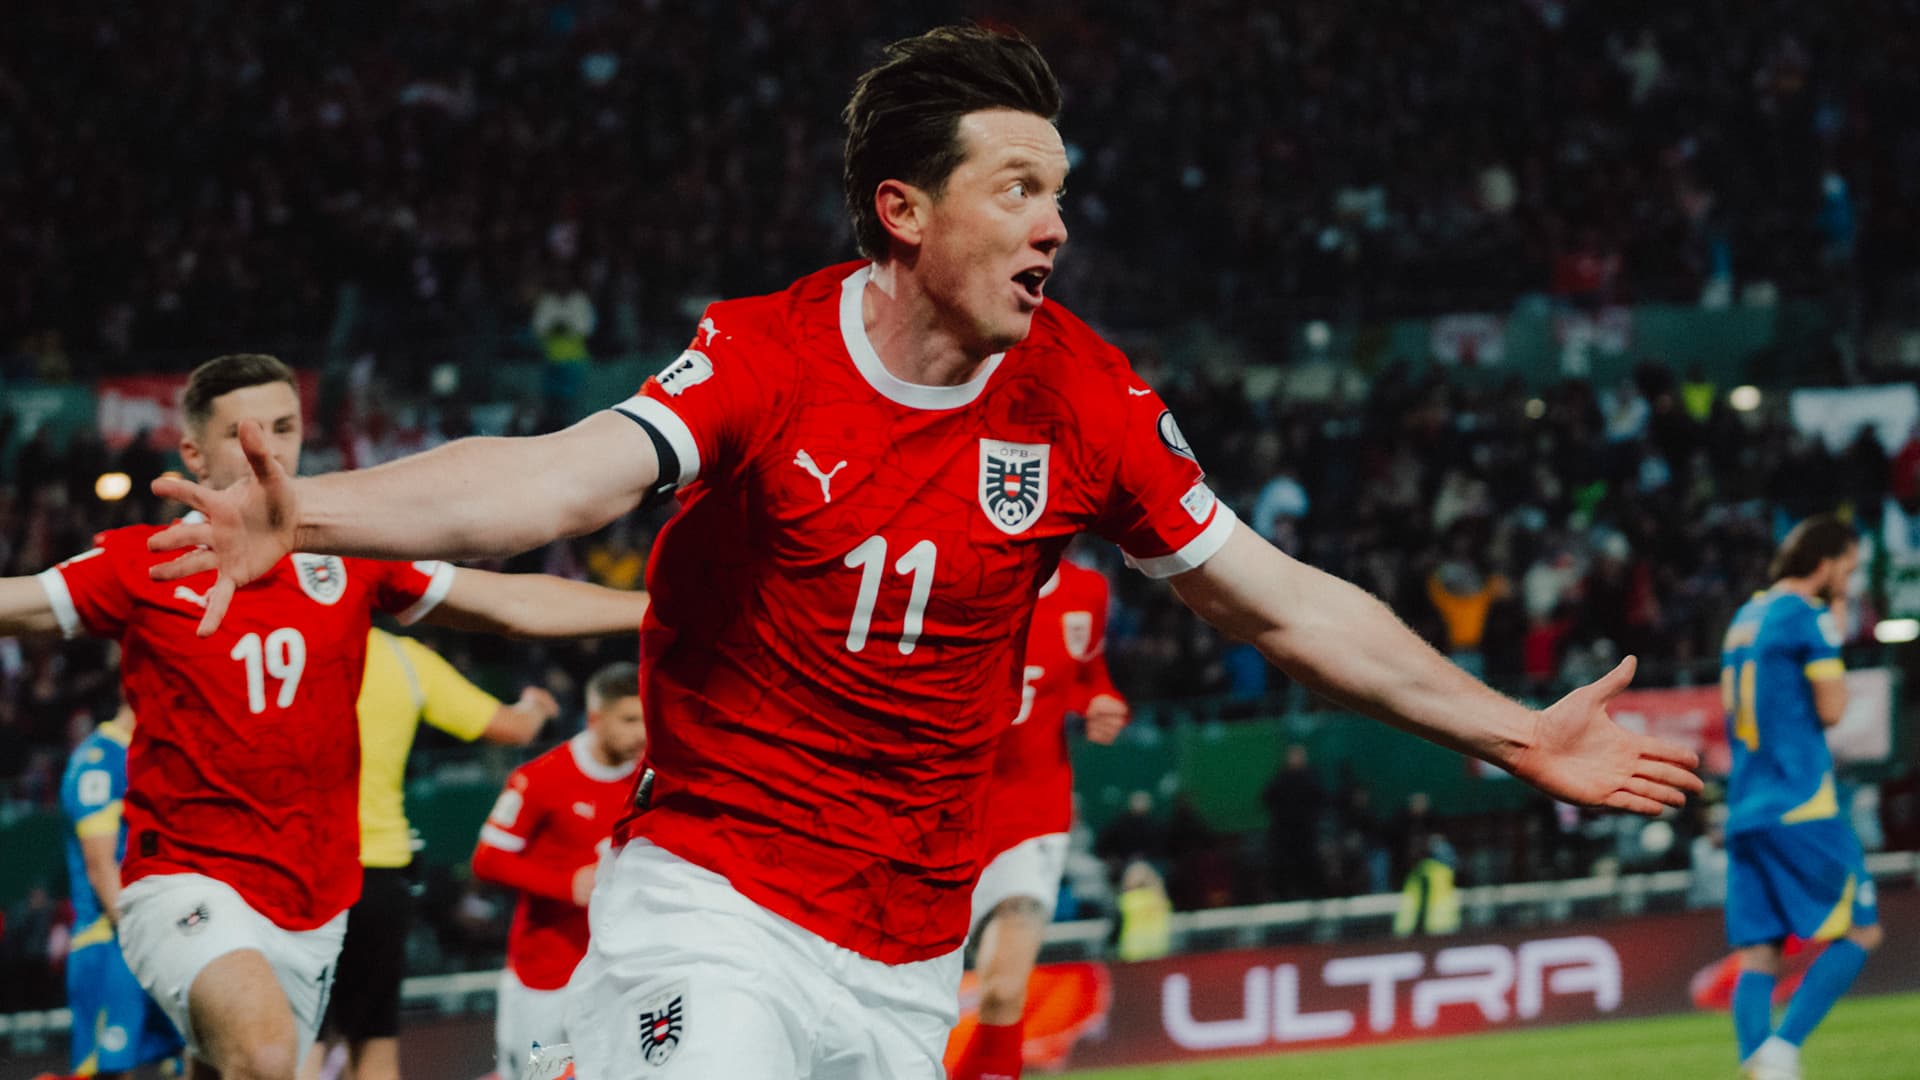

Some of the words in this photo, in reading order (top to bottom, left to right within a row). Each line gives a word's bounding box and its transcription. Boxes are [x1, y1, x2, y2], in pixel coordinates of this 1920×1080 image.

[844, 535, 937, 655] 11
[230, 627, 306, 714] 19
[1162, 936, 1622, 1051] ULTRA
